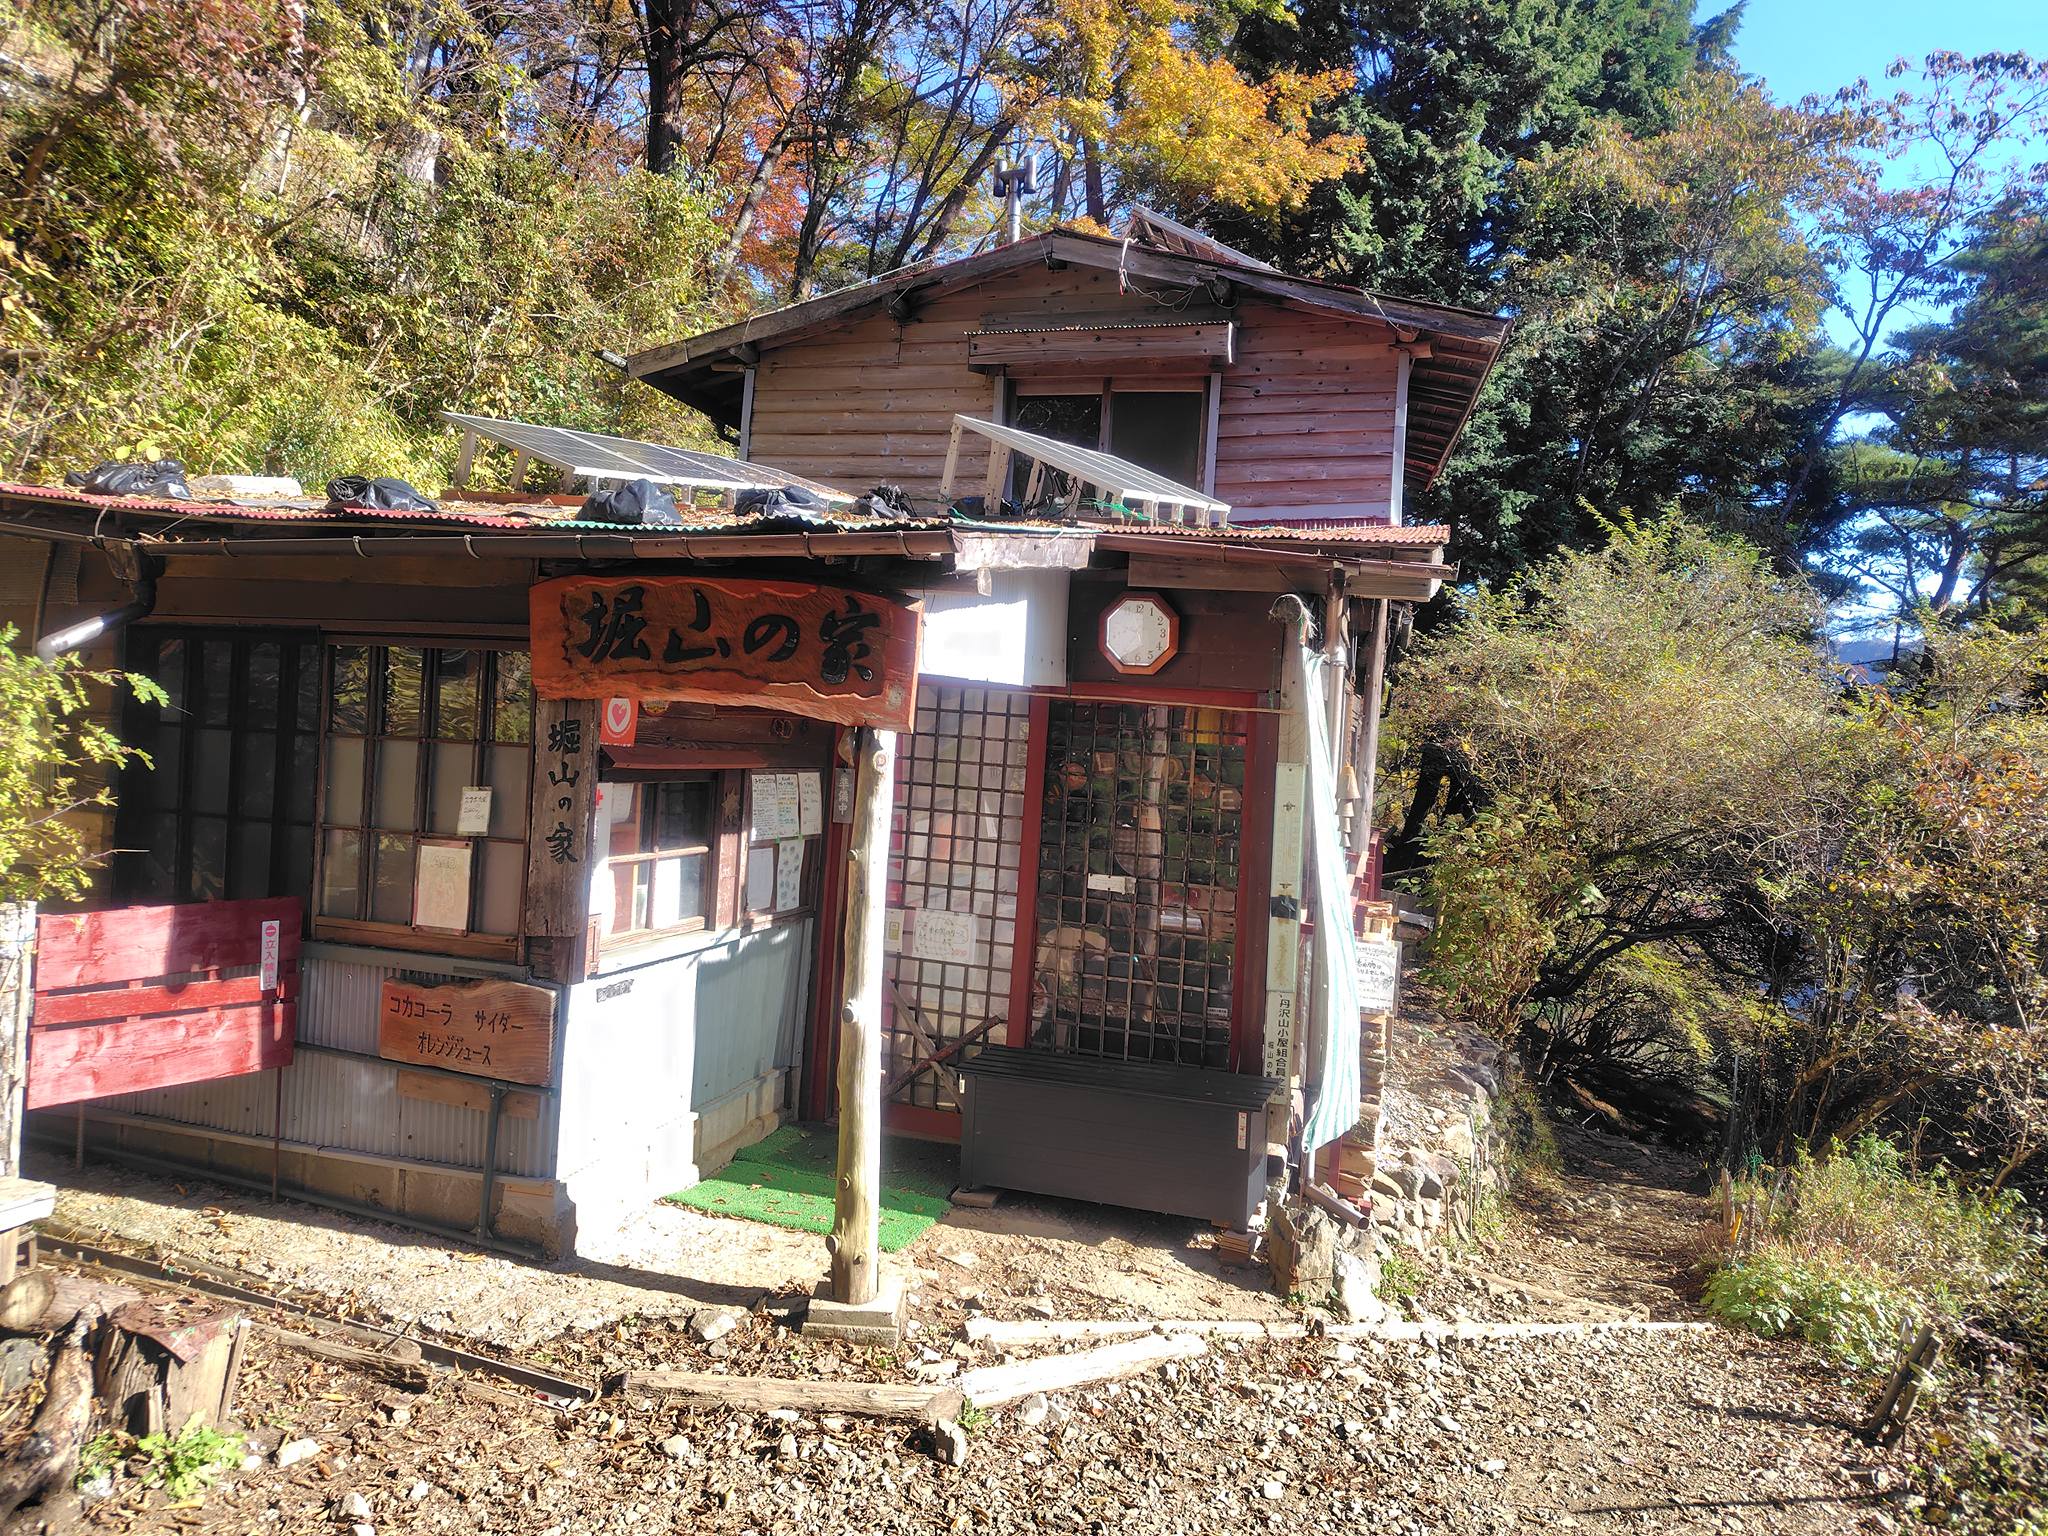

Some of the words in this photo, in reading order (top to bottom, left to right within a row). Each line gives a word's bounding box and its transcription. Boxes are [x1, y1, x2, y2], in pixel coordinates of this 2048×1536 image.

[1136, 604, 1144, 613] 12
[1150, 607, 1154, 617] 1
[1157, 616, 1164, 626] 2
[576, 586, 881, 684] 堀山の家
[1160, 629, 1166, 638] 3
[1156, 642, 1163, 650] 4
[1147, 650, 1153, 659] 5
[545, 719, 581, 864] 堀山の家
[263, 939, 277, 984] 立入禁止
[390, 995, 453, 1026] コカコーラ
[474, 1010, 524, 1034] サイダー
[417, 1031, 492, 1067] オレンジジュース
